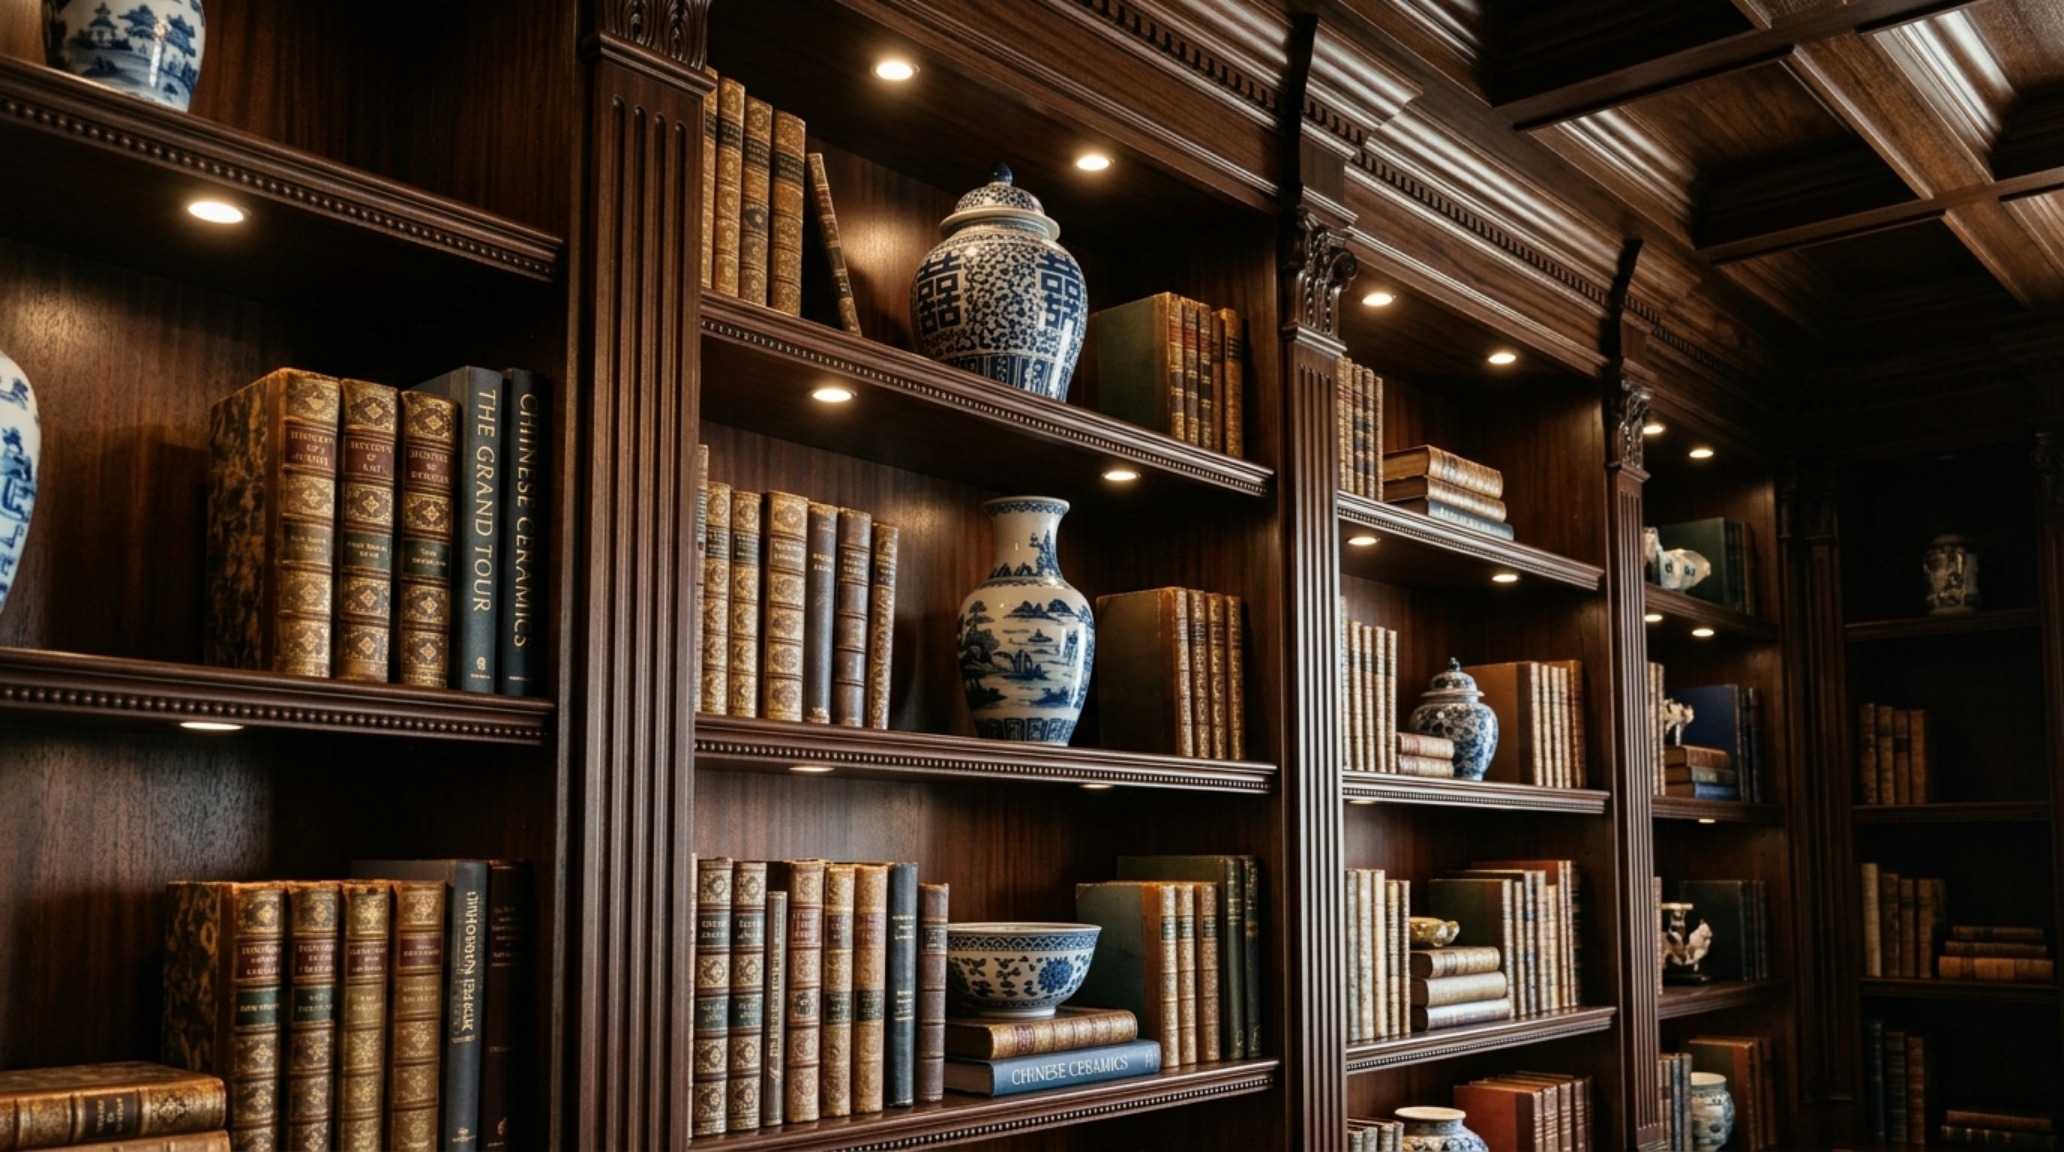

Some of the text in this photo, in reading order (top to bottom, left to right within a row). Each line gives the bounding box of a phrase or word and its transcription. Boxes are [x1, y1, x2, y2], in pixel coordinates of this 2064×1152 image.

[472, 389, 496, 612] THE GRAND TOUR
[513, 516, 535, 647] CERAMICS
